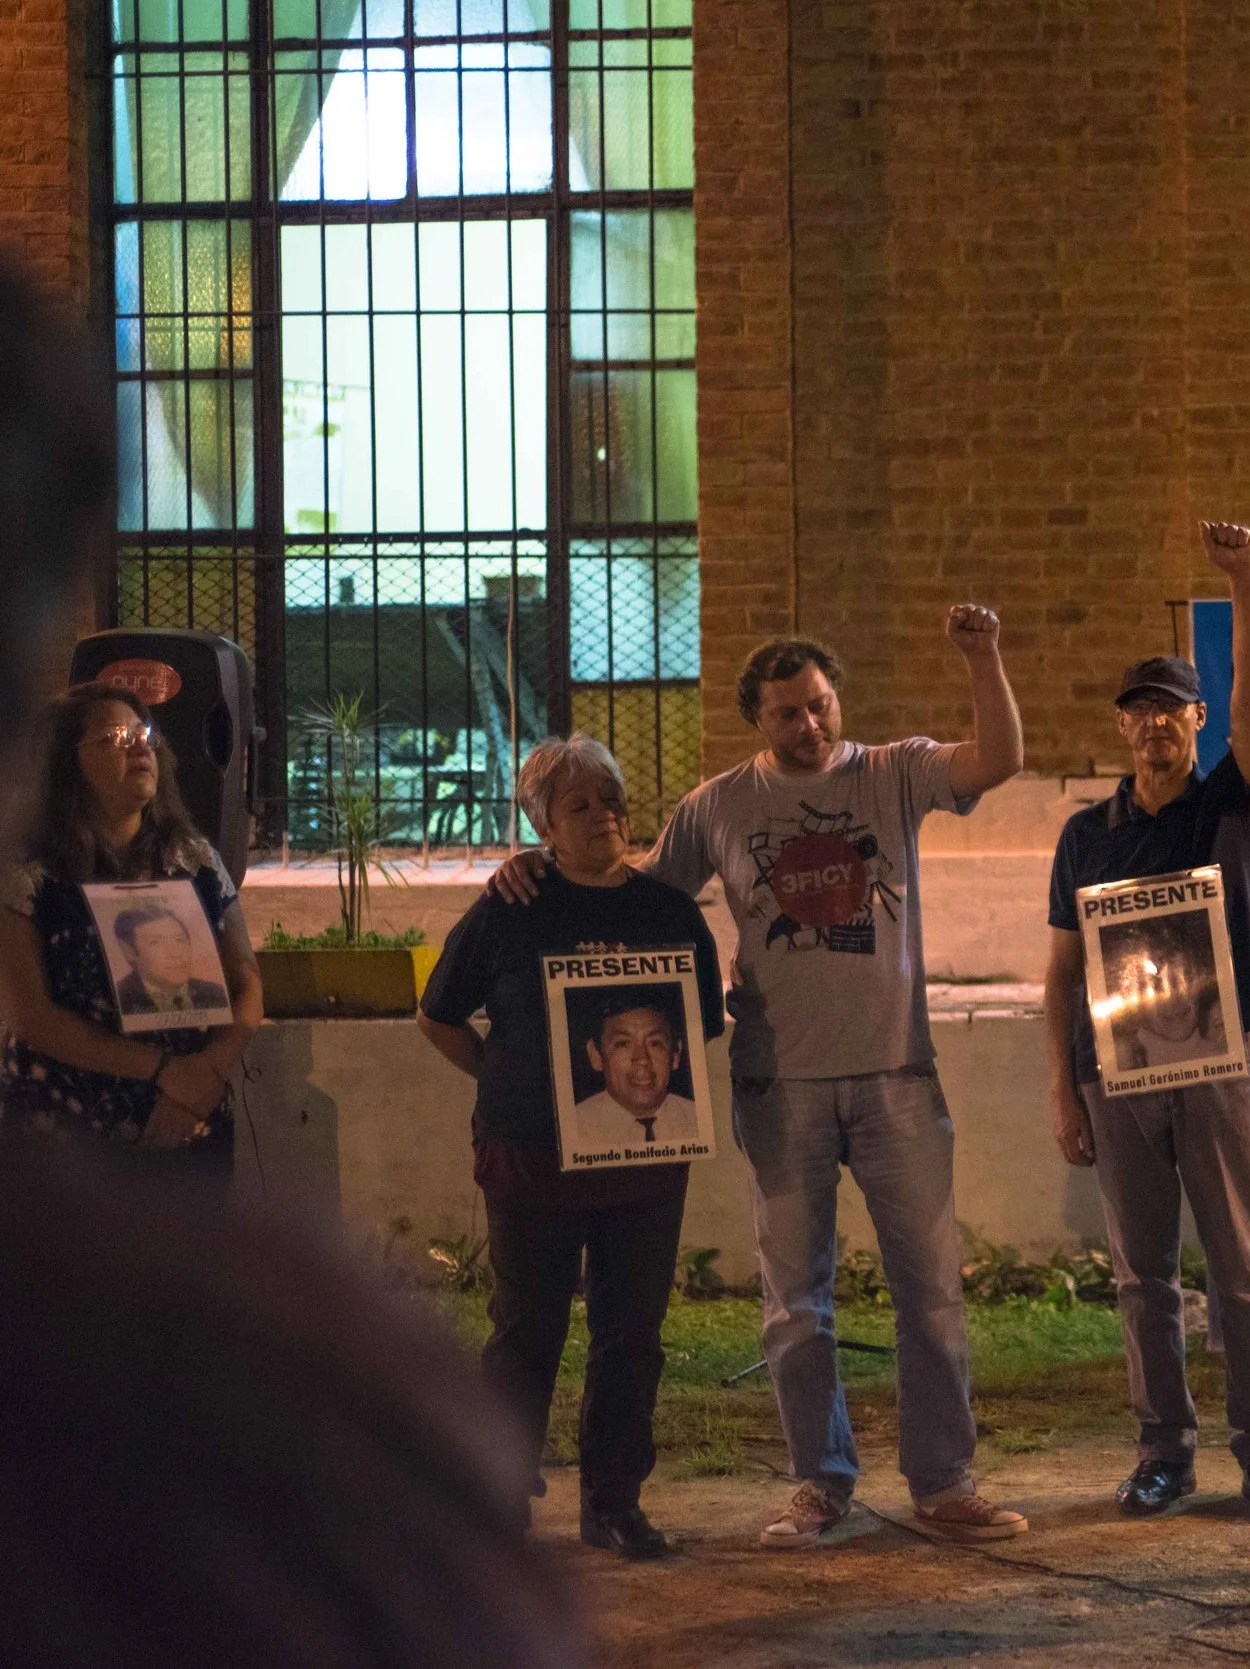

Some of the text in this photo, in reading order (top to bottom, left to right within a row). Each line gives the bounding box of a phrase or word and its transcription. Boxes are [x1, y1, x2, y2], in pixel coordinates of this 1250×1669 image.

[1084, 879, 1219, 920] PRESENTE
[548, 954, 692, 980] PRESENTE
[1107, 1061, 1244, 1093] Samuel Gerónimo Romero
[572, 1143, 709, 1166] Segundo Bonifacio Arias
